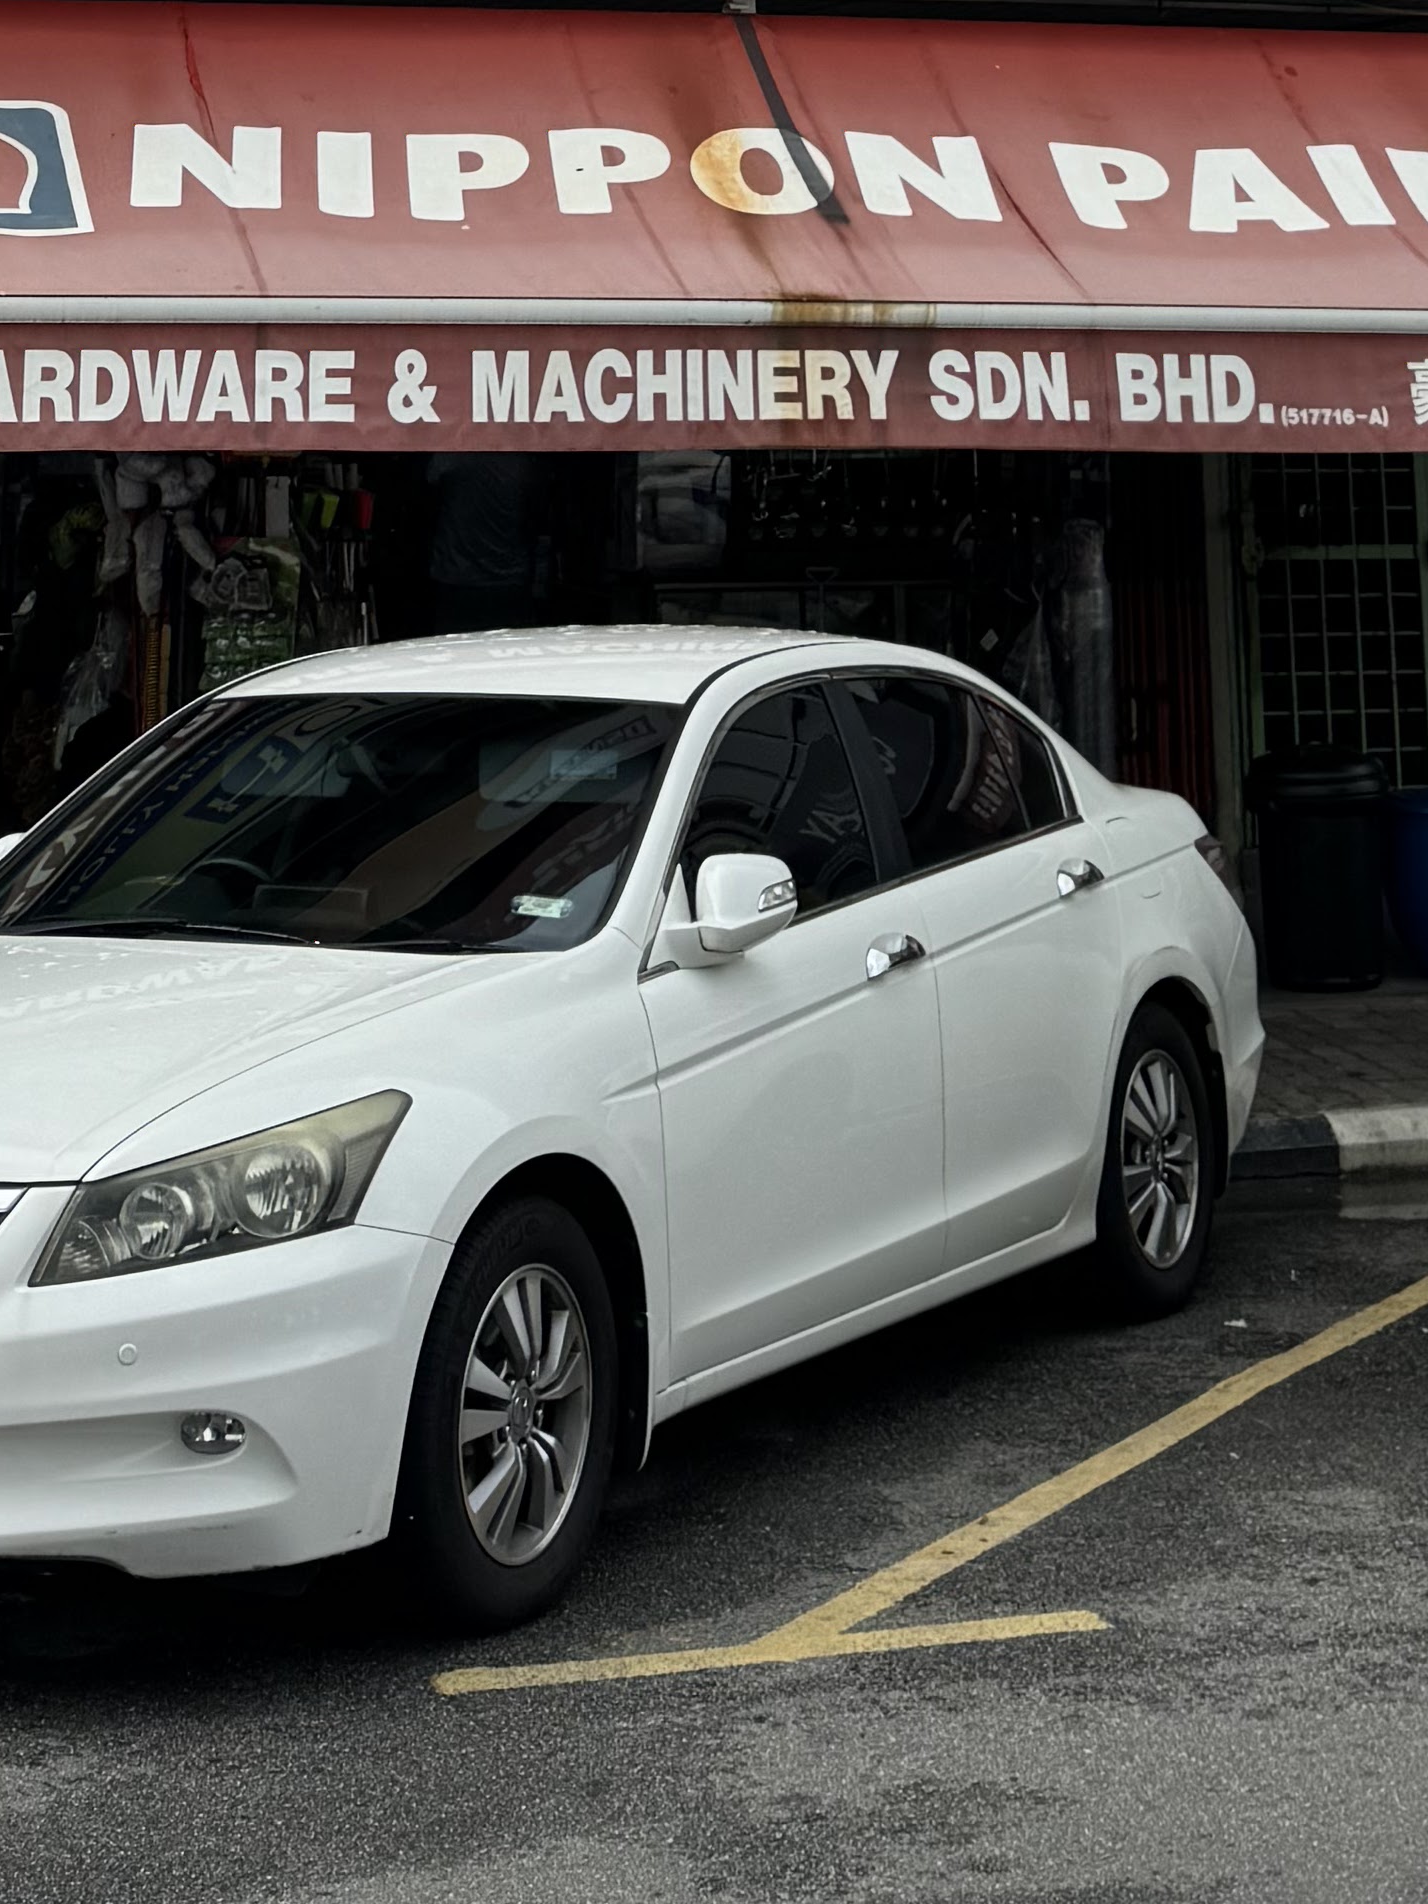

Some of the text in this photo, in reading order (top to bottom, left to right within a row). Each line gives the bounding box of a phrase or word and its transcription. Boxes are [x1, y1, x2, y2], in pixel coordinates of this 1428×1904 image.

[129, 123, 1002, 224] NIPPON
[387, 348, 441, 425] &
[470, 346, 900, 426] MACHINERY
[928, 350, 1091, 425] SDN.
[1117, 353, 1276, 426] BHD.
[1280, 404, 1390, 429] (517716-A)
